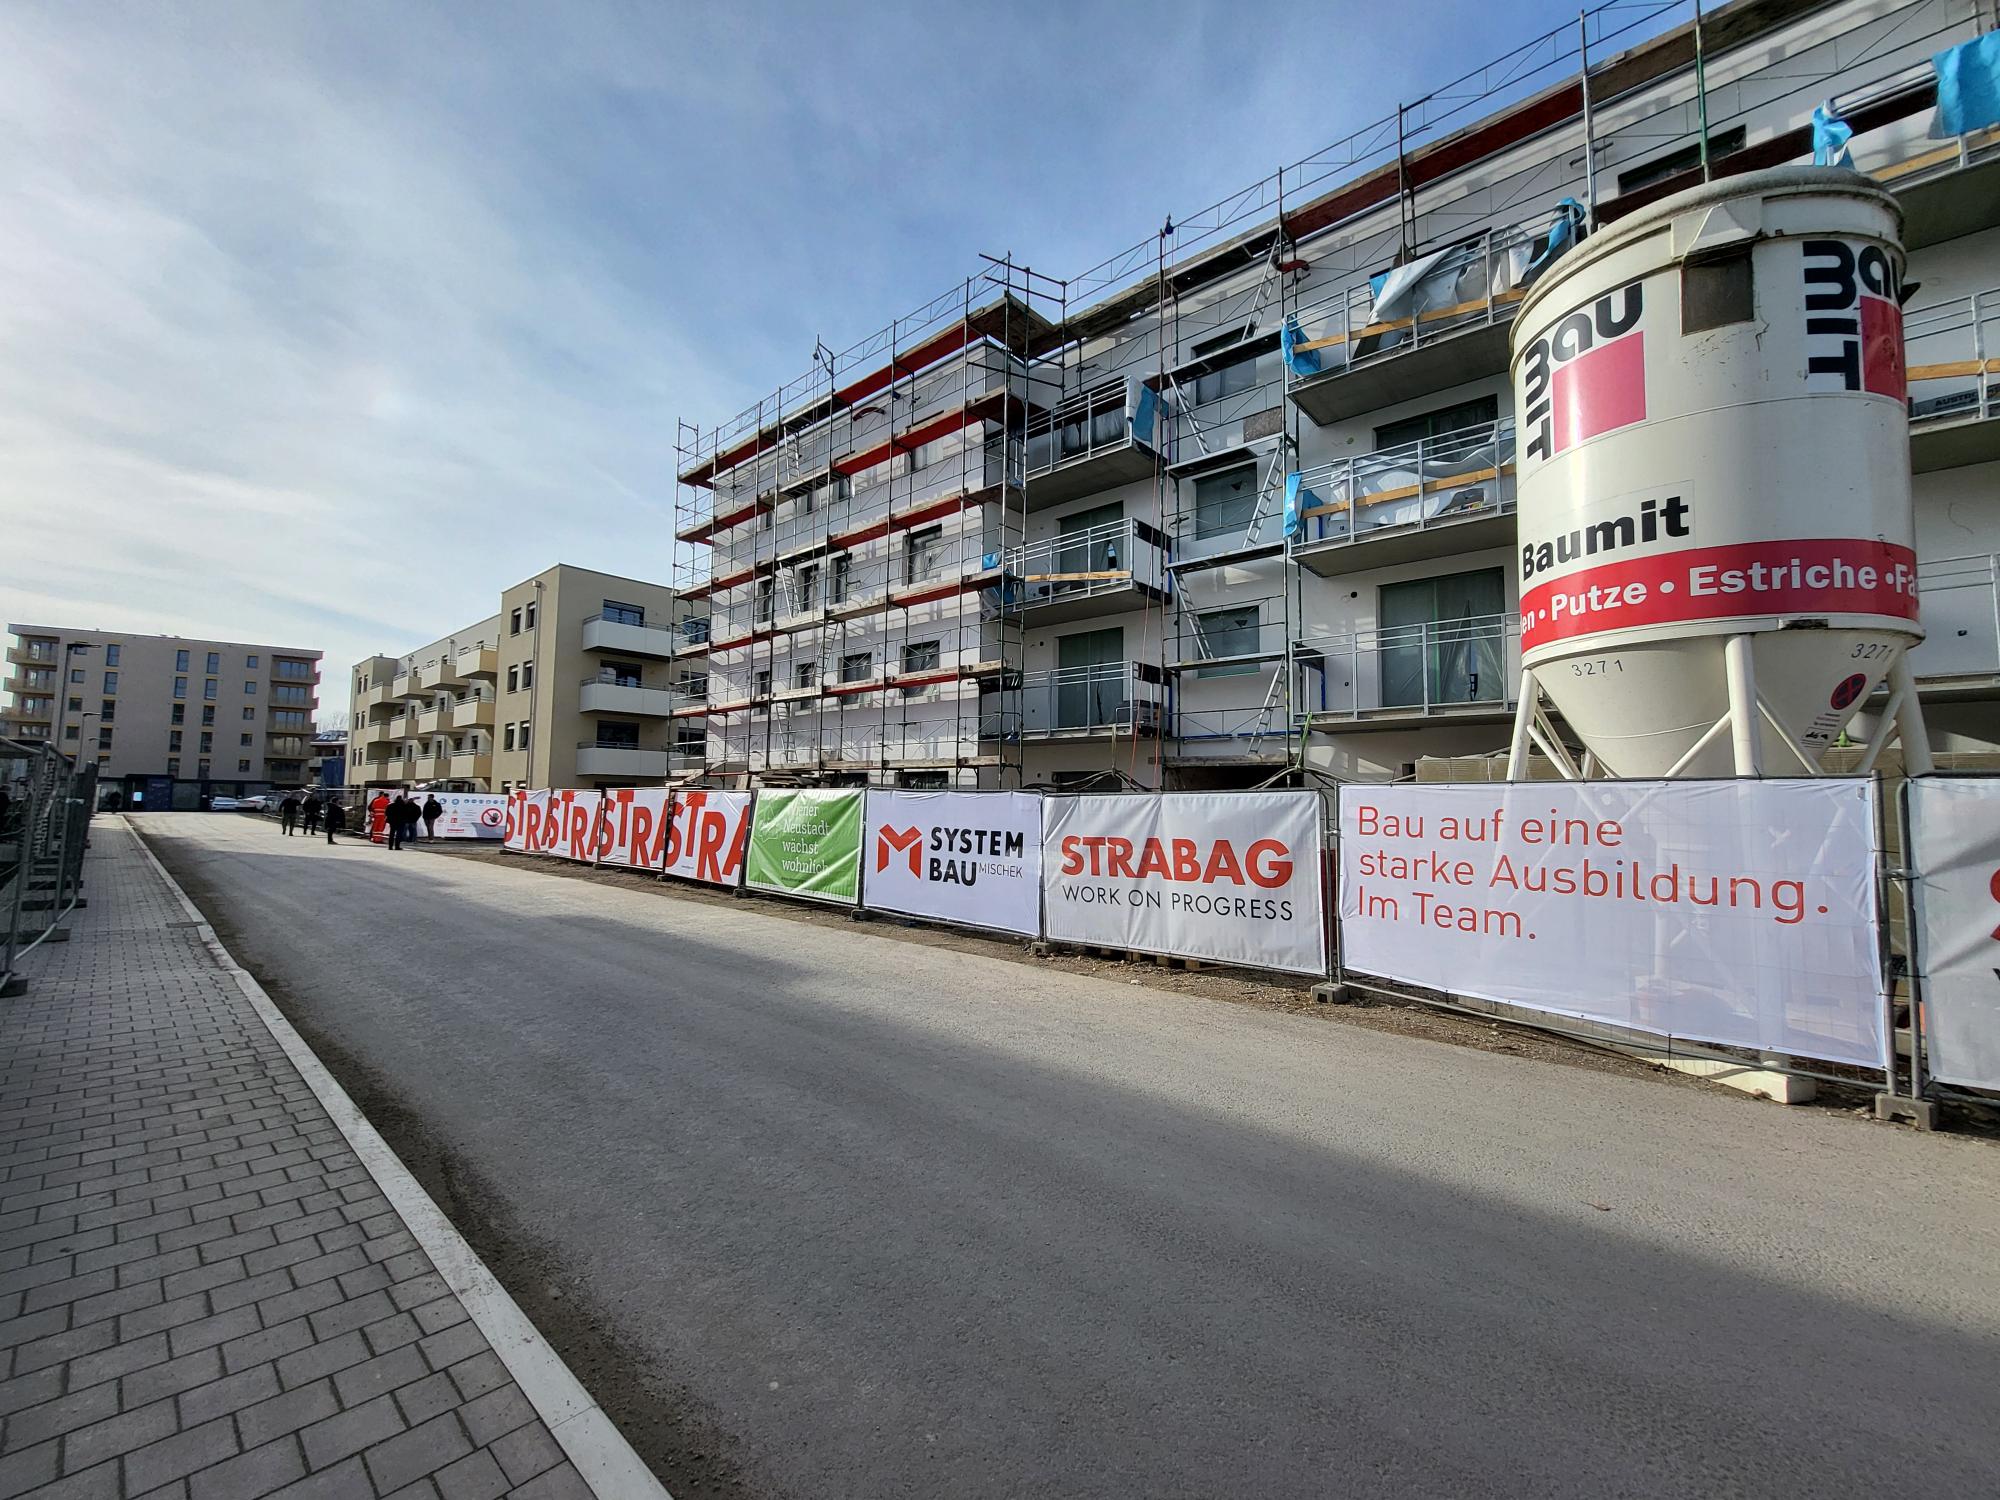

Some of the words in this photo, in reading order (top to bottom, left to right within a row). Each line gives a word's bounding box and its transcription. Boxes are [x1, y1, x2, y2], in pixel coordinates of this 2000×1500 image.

[1522, 496, 1690, 581] Baumit
[1551, 582, 1647, 621] Putze
[1689, 558, 1877, 597] Estriche
[1570, 659, 1624, 677] 3271
[1851, 643, 1894, 663] 3271
[783, 819, 830, 836] Neustadt
[930, 826, 1023, 859] SYSTEM
[1358, 805, 1424, 838] Bau
[1439, 808, 1505, 843] auf
[1520, 808, 1623, 847] eine
[782, 838, 819, 855] wächst
[1061, 835, 1294, 889] STRABAG
[929, 857, 977, 887] BAU
[979, 862, 1023, 879] MISCHEK
[1359, 850, 1475, 886] starke
[1489, 854, 1830, 925] Ausbildung.
[1062, 884, 1121, 907] WORK
[1128, 889, 1161, 909] ON
[1171, 890, 1293, 922] PROGRESS
[1358, 886, 1398, 921] Im
[1412, 892, 1537, 940] Team.
